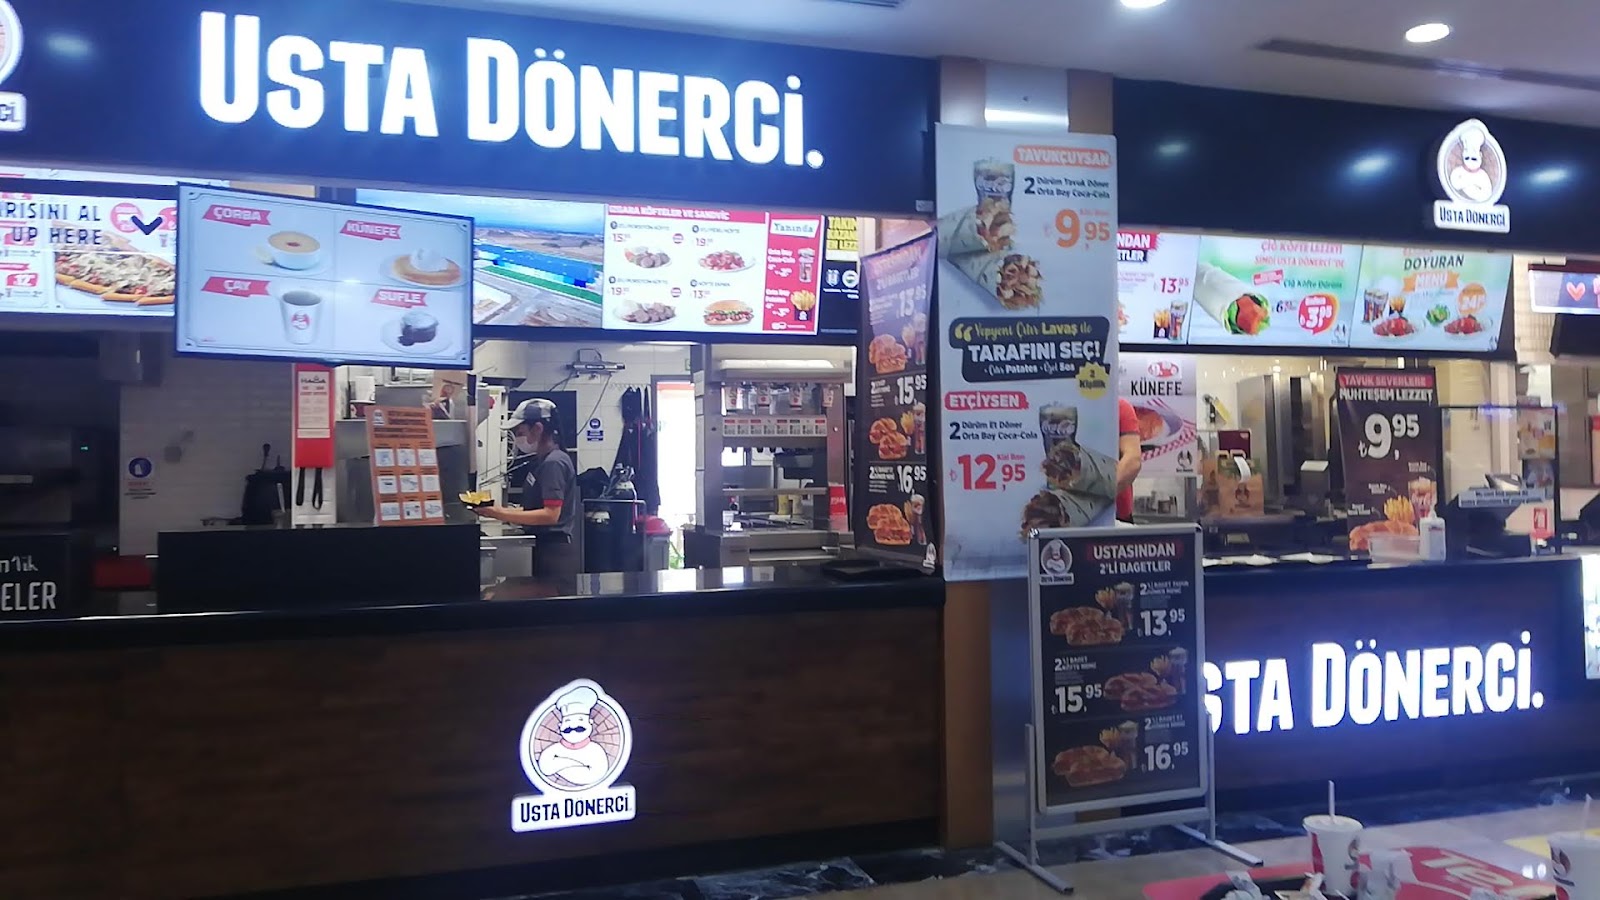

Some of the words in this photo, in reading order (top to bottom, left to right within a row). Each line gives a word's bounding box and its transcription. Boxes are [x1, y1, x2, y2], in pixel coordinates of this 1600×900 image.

[200, 11, 438, 137] USTA
[1024, 177, 1035, 194] 2
[78, 205, 101, 221] AL
[213, 207, 261, 221] ÇORBA
[1440, 206, 1464, 223] USTA
[13, 226, 38, 242] UP
[50, 227, 101, 245] HERE
[346, 222, 397, 237] KÜNEFE
[1404, 254, 1464, 270] DOYURAN
[1042, 322, 1077, 336] Lavaş
[968, 342, 1055, 362] TARAFINI
[1060, 341, 1100, 361] SEÇ!
[1131, 377, 1182, 396] KÜNEFE
[950, 390, 1020, 410] ETÇİYSEN
[949, 422, 961, 440] 2
[962, 421, 988, 429] Dürüm
[999, 421, 1023, 429] Döner
[962, 432, 980, 440] Orta
[981, 431, 996, 441] Boy
[998, 431, 1038, 440] Coca-Cola
[1094, 543, 1175, 559] USTASINDAN
[1120, 561, 1171, 573] BAGETLER
[1, 582, 56, 611] ELER
[520, 802, 560, 823] USTA
